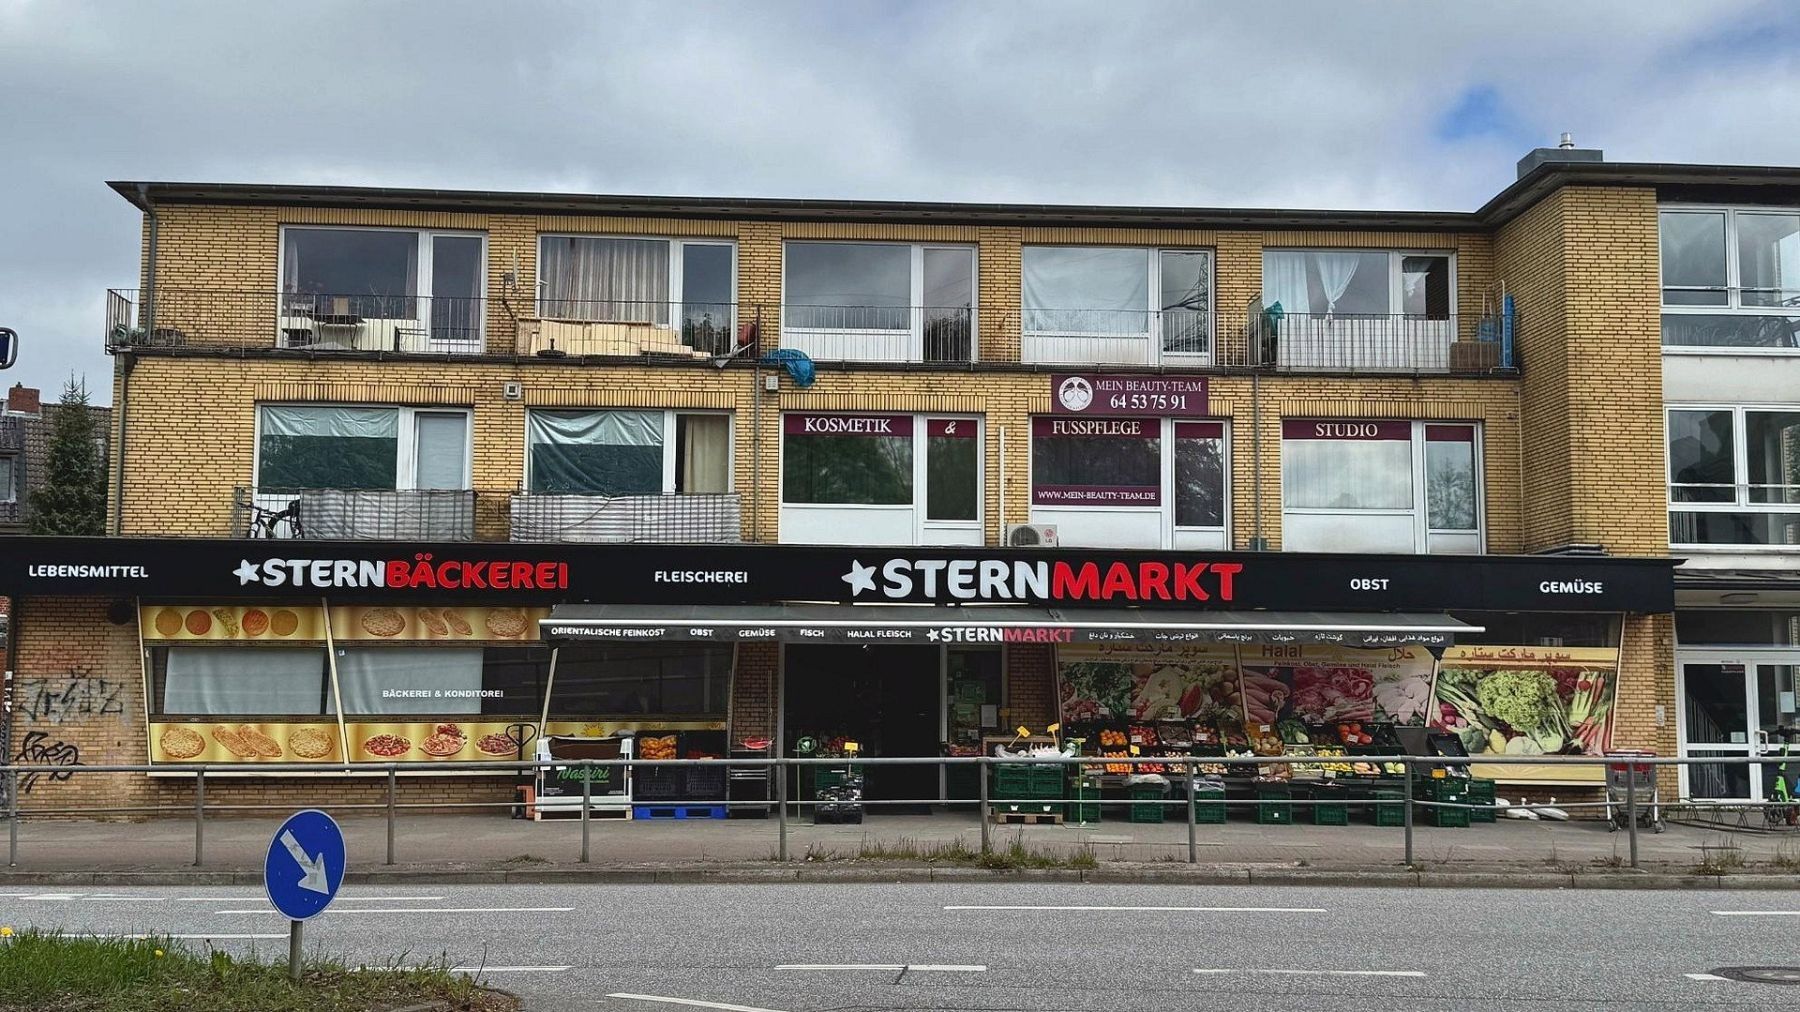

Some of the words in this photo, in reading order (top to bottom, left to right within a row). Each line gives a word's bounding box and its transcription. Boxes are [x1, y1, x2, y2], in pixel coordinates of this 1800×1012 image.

[1096, 380, 1123, 391] MEIN
[1126, 380, 1202, 392] BEAUTY-TEAM
[1110, 394, 1127, 409] 64
[1130, 394, 1148, 409] 53
[1150, 394, 1167, 410] 75
[1170, 394, 1187, 410] 91
[804, 417, 892, 433] KOSMETIK
[944, 421, 957, 434] &
[1052, 420, 1141, 435] FUSSPFLEGE
[1315, 423, 1378, 437] STUDIO
[1038, 490, 1156, 501] WWW.MEIN-BEAUTY-TEAM.DE
[28, 564, 149, 579] LEBENSMITTEL
[262, 553, 568, 589] STERNBÄCKEREI
[654, 570, 748, 583] FLEISCHEREI
[882, 558, 1243, 600] STERNMARKT
[1350, 577, 1390, 591] OBST
[1539, 578, 1603, 594] GEMÜSE
[551, 626, 621, 637] ORIENTALISCHE
[622, 628, 666, 637] FEINKOST
[689, 628, 714, 637] OBST
[738, 627, 776, 638] GEMÜSE
[800, 628, 825, 638] FISCH
[847, 630, 875, 638] HALAL
[876, 630, 912, 638] FLEISCH
[941, 627, 1074, 643] STERNMARKT
[1262, 644, 1303, 658] Halal
[1388, 646, 1416, 662] حلال
[382, 688, 432, 699] BÄCKEREI
[434, 689, 442, 699] &
[444, 689, 504, 698] KONDITOREI
